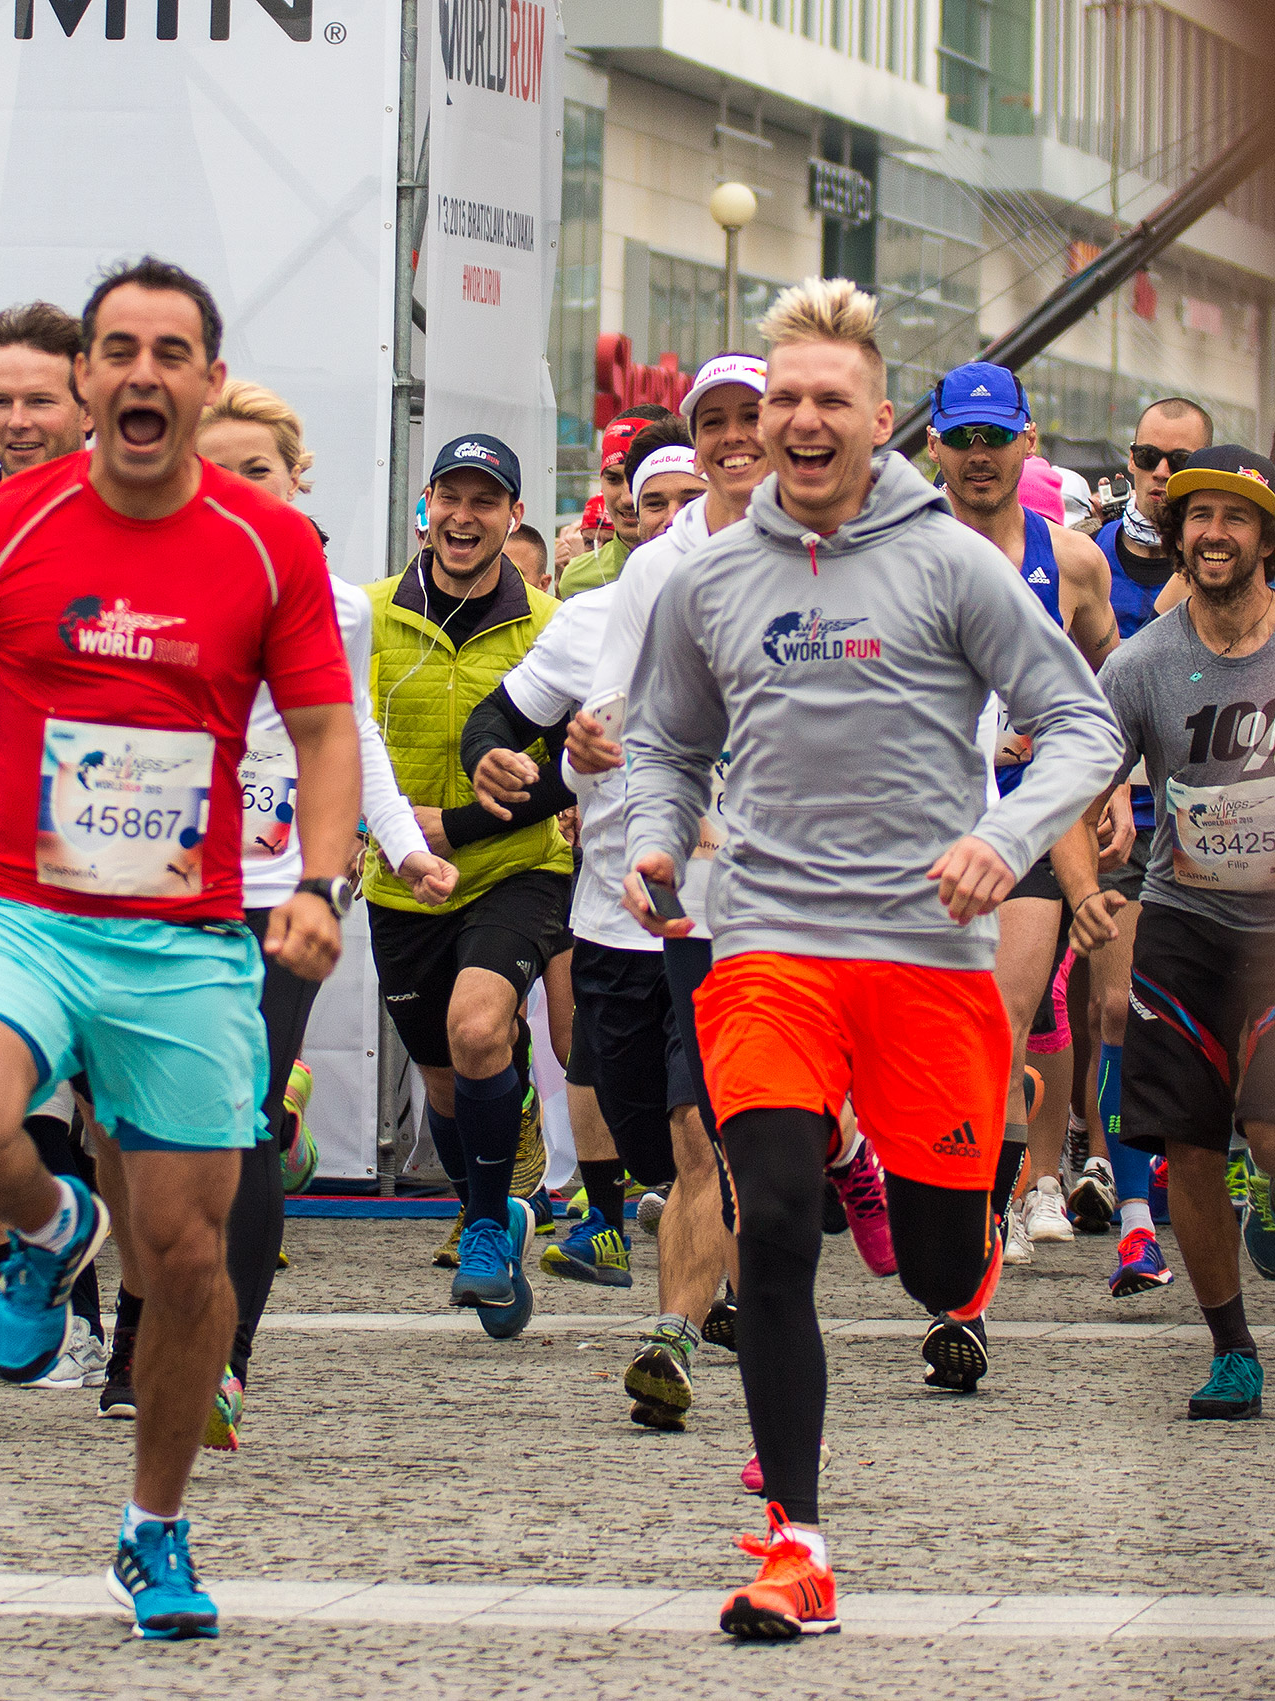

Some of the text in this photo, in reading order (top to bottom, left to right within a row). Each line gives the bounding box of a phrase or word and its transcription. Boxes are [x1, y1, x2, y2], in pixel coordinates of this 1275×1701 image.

[242, 784, 274, 813] 53
[75, 803, 183, 840] 45867
[1196, 831, 1275, 856] 43425
[1227, 860, 1249, 871] Filip
[1179, 869, 1220, 883] GARMIN
[933, 1142, 981, 1158] adidas
